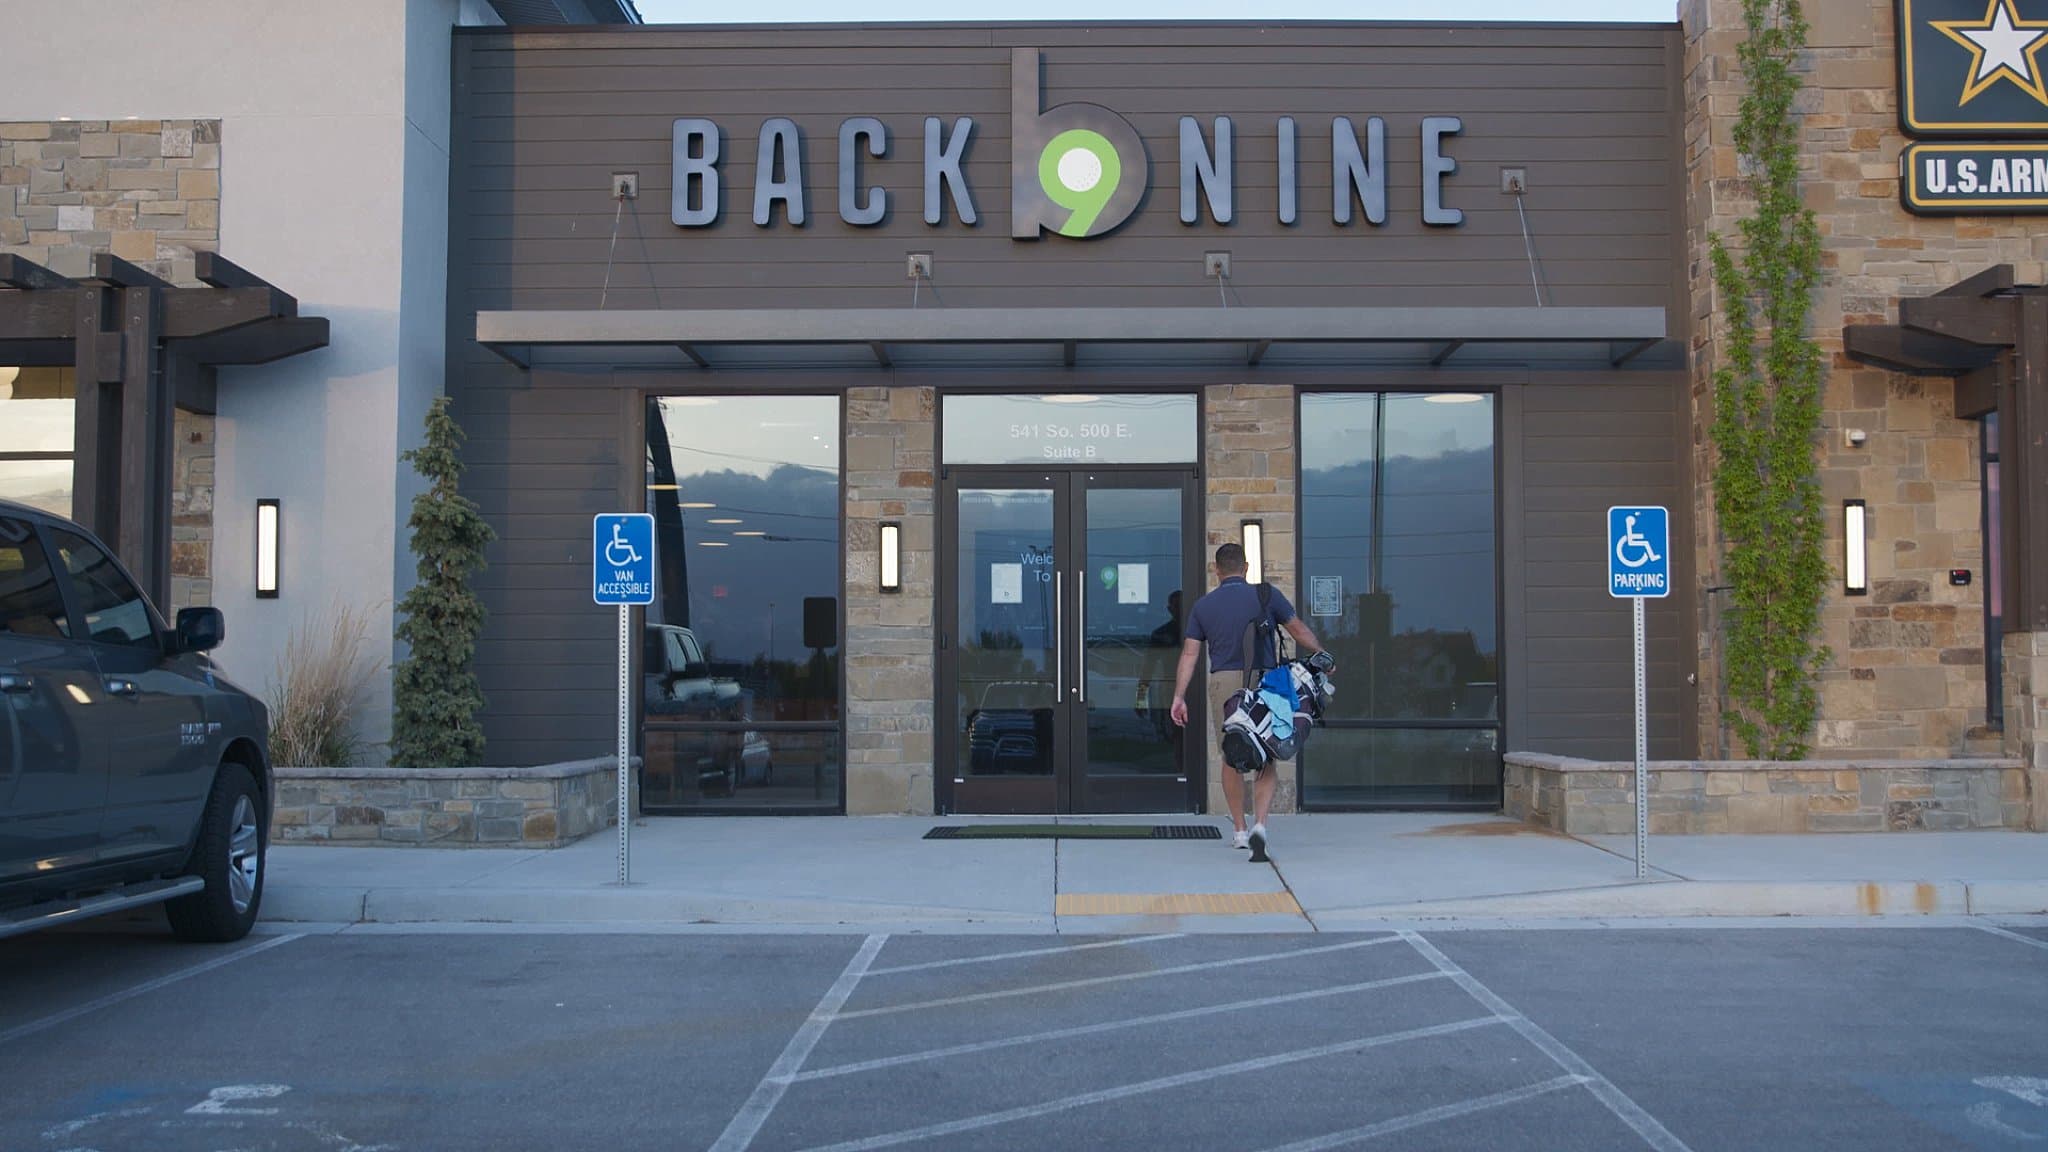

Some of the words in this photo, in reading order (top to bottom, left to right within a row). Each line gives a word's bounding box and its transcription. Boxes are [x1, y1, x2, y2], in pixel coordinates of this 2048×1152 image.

[671, 116, 977, 227] BACK
[1178, 115, 1464, 226] NINE
[1010, 423, 1039, 439] 541
[1080, 422, 1111, 438] 500
[1116, 422, 1133, 438] E.
[1043, 444, 1081, 458] Suite
[1086, 445, 1097, 458] B
[614, 570, 634, 582] VAN
[1033, 569, 1051, 582] To
[1614, 573, 1665, 588] PARKING
[598, 582, 650, 595] ACCESSIBLE
